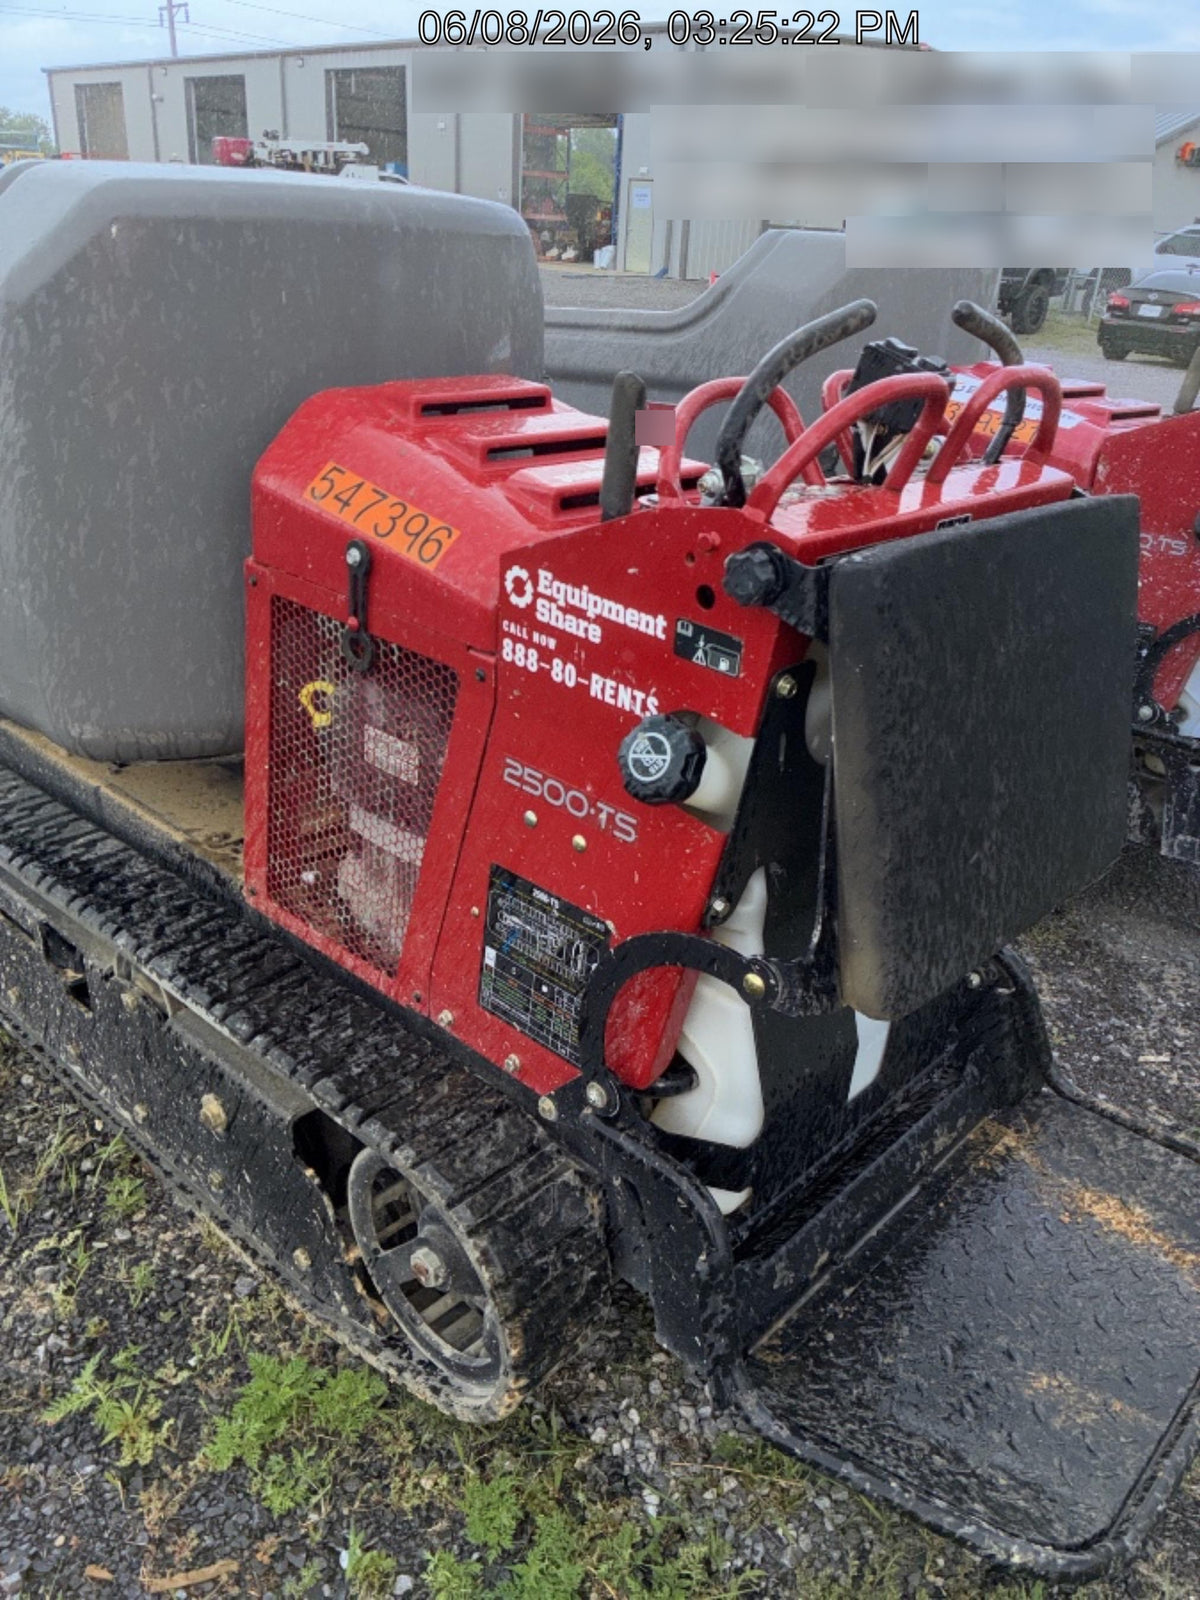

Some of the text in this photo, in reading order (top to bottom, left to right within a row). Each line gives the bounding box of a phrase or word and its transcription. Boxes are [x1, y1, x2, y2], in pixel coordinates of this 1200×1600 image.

[310, 465, 453, 564] 547396
[502, 620, 558, 650] CALL NOW
[535, 597, 602, 645] Share
[537, 568, 668, 641] Equipment
[502, 637, 659, 718] 888-80-RENTS
